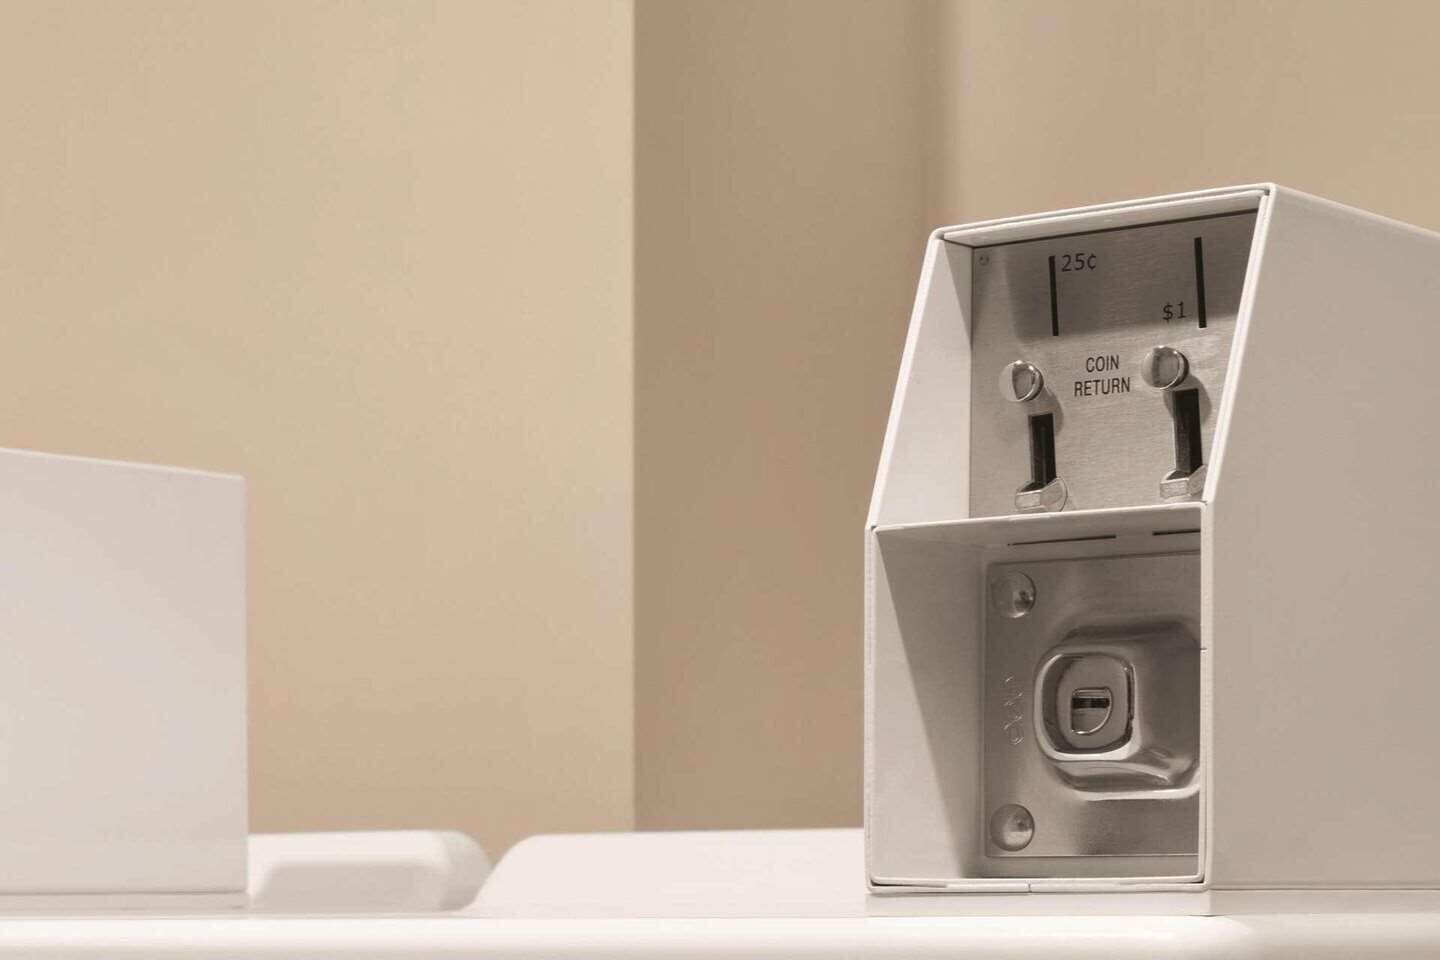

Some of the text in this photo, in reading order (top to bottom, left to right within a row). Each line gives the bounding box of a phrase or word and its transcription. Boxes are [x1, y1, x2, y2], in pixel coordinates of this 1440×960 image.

[1061, 252, 1097, 272] 25¢
[1162, 301, 1186, 322] $1
[1086, 355, 1120, 373] COIN
[1074, 377, 1130, 397] RETURN
